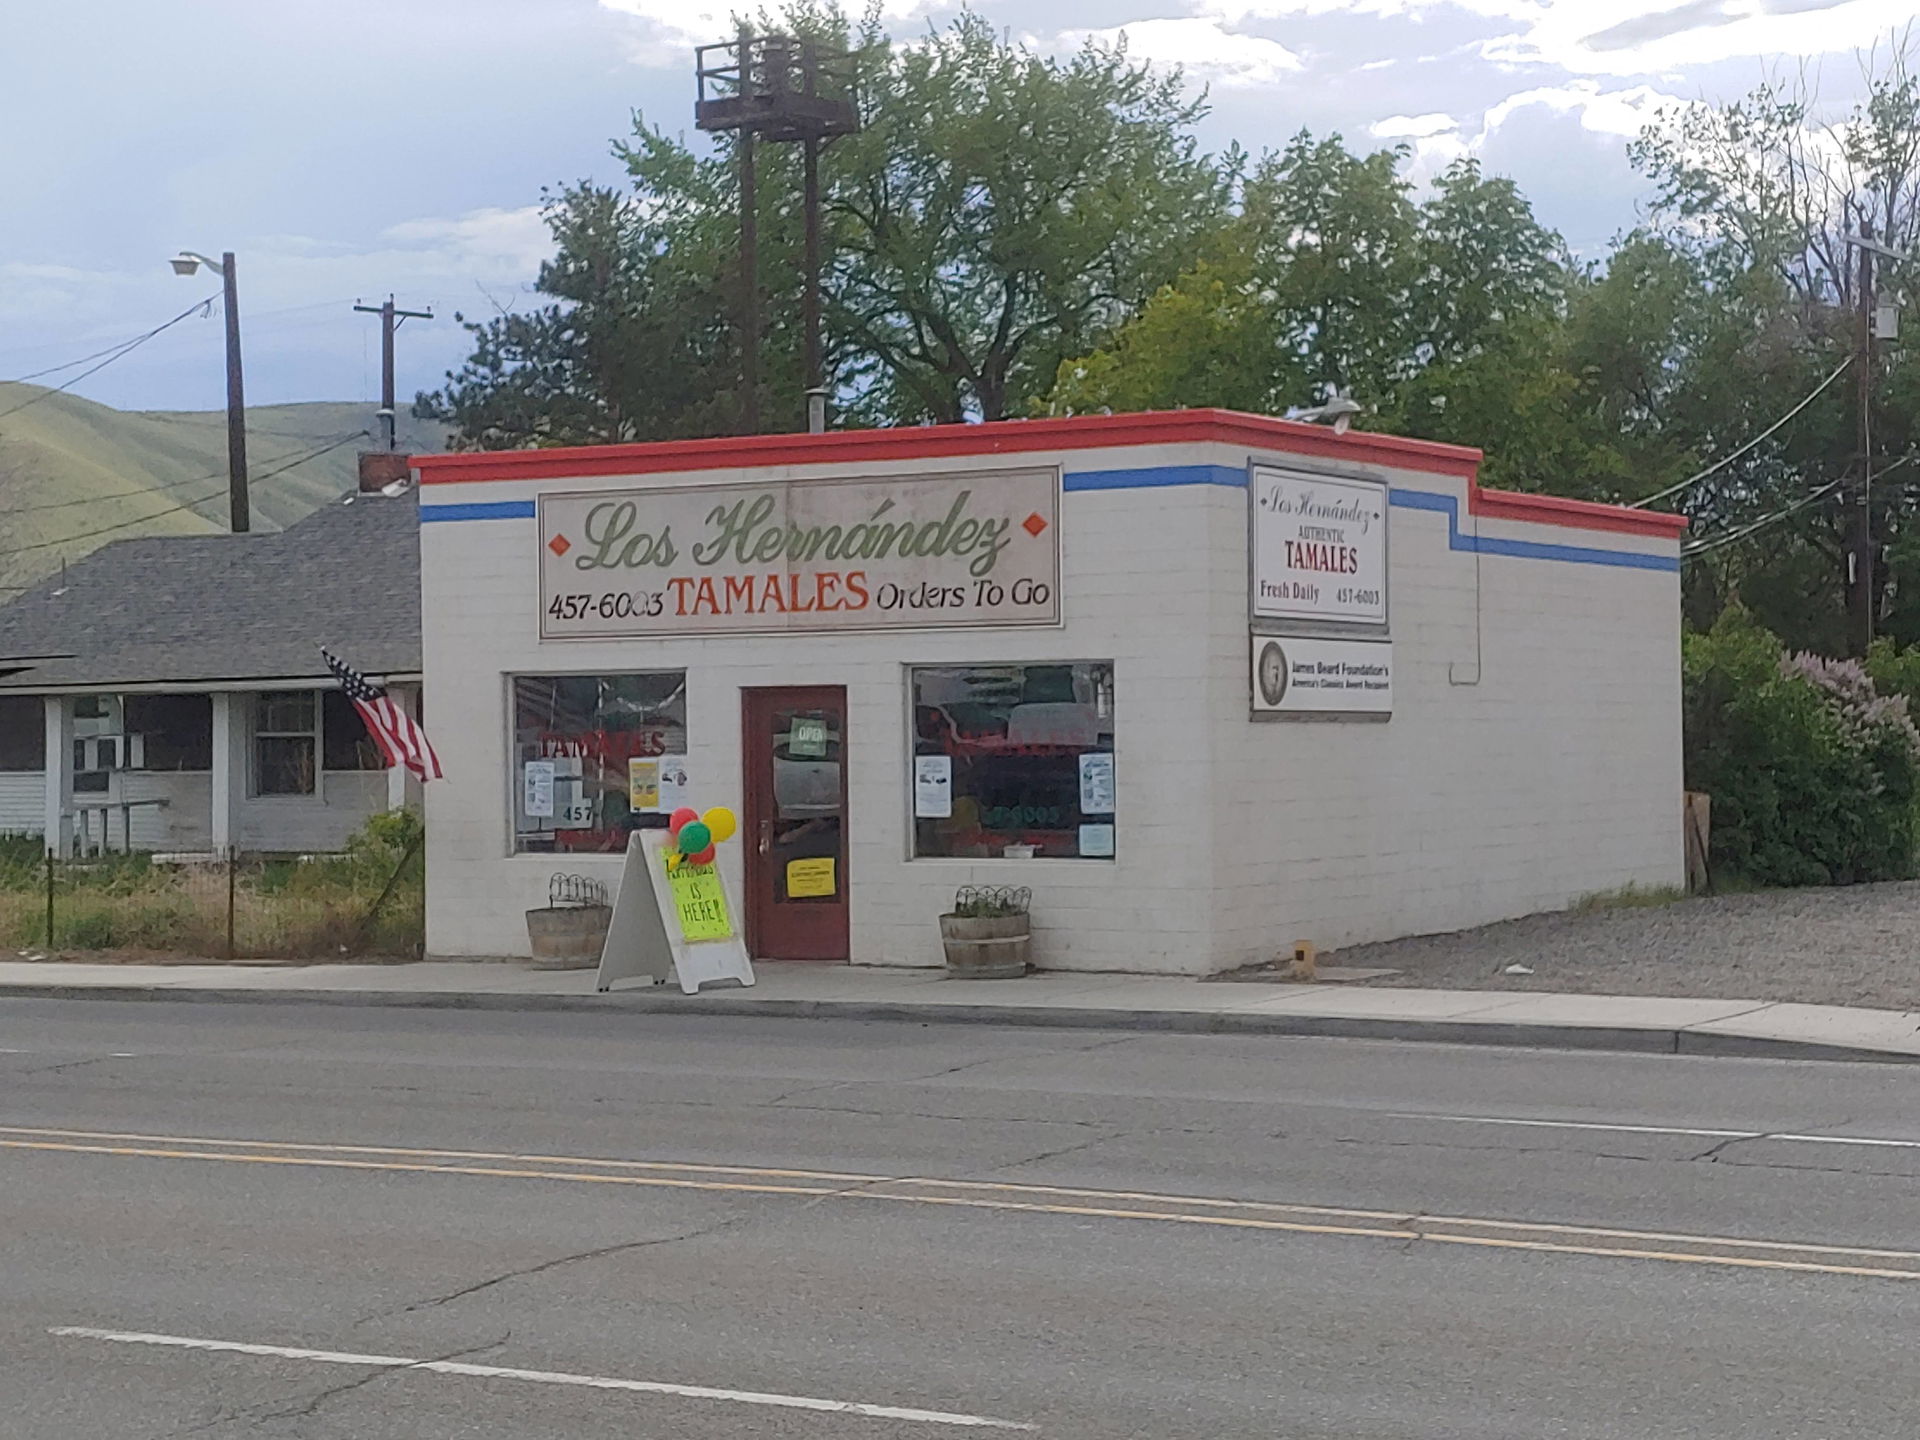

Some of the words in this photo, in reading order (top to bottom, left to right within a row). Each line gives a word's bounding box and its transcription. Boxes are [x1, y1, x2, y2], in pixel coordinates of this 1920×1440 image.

[1269, 485, 1292, 515] Los
[575, 500, 678, 570] Los
[691, 490, 1010, 577] Hernández
[1298, 525, 1345, 544] AUTHENTIC
[1284, 540, 1358, 575] TAMALES
[548, 590, 664, 620] 457-6003
[667, 571, 869, 616] TAMALES
[876, 581, 965, 610] Orders
[972, 578, 1004, 607] To
[1010, 577, 1049, 606] Go
[1260, 579, 1290, 600] Fresh
[1292, 581, 1320, 605] Daily
[1336, 587, 1380, 606] 457-6003
[798, 726, 823, 742] OPEN
[689, 882, 702, 900] IS
[682, 898, 724, 925] HERE!
